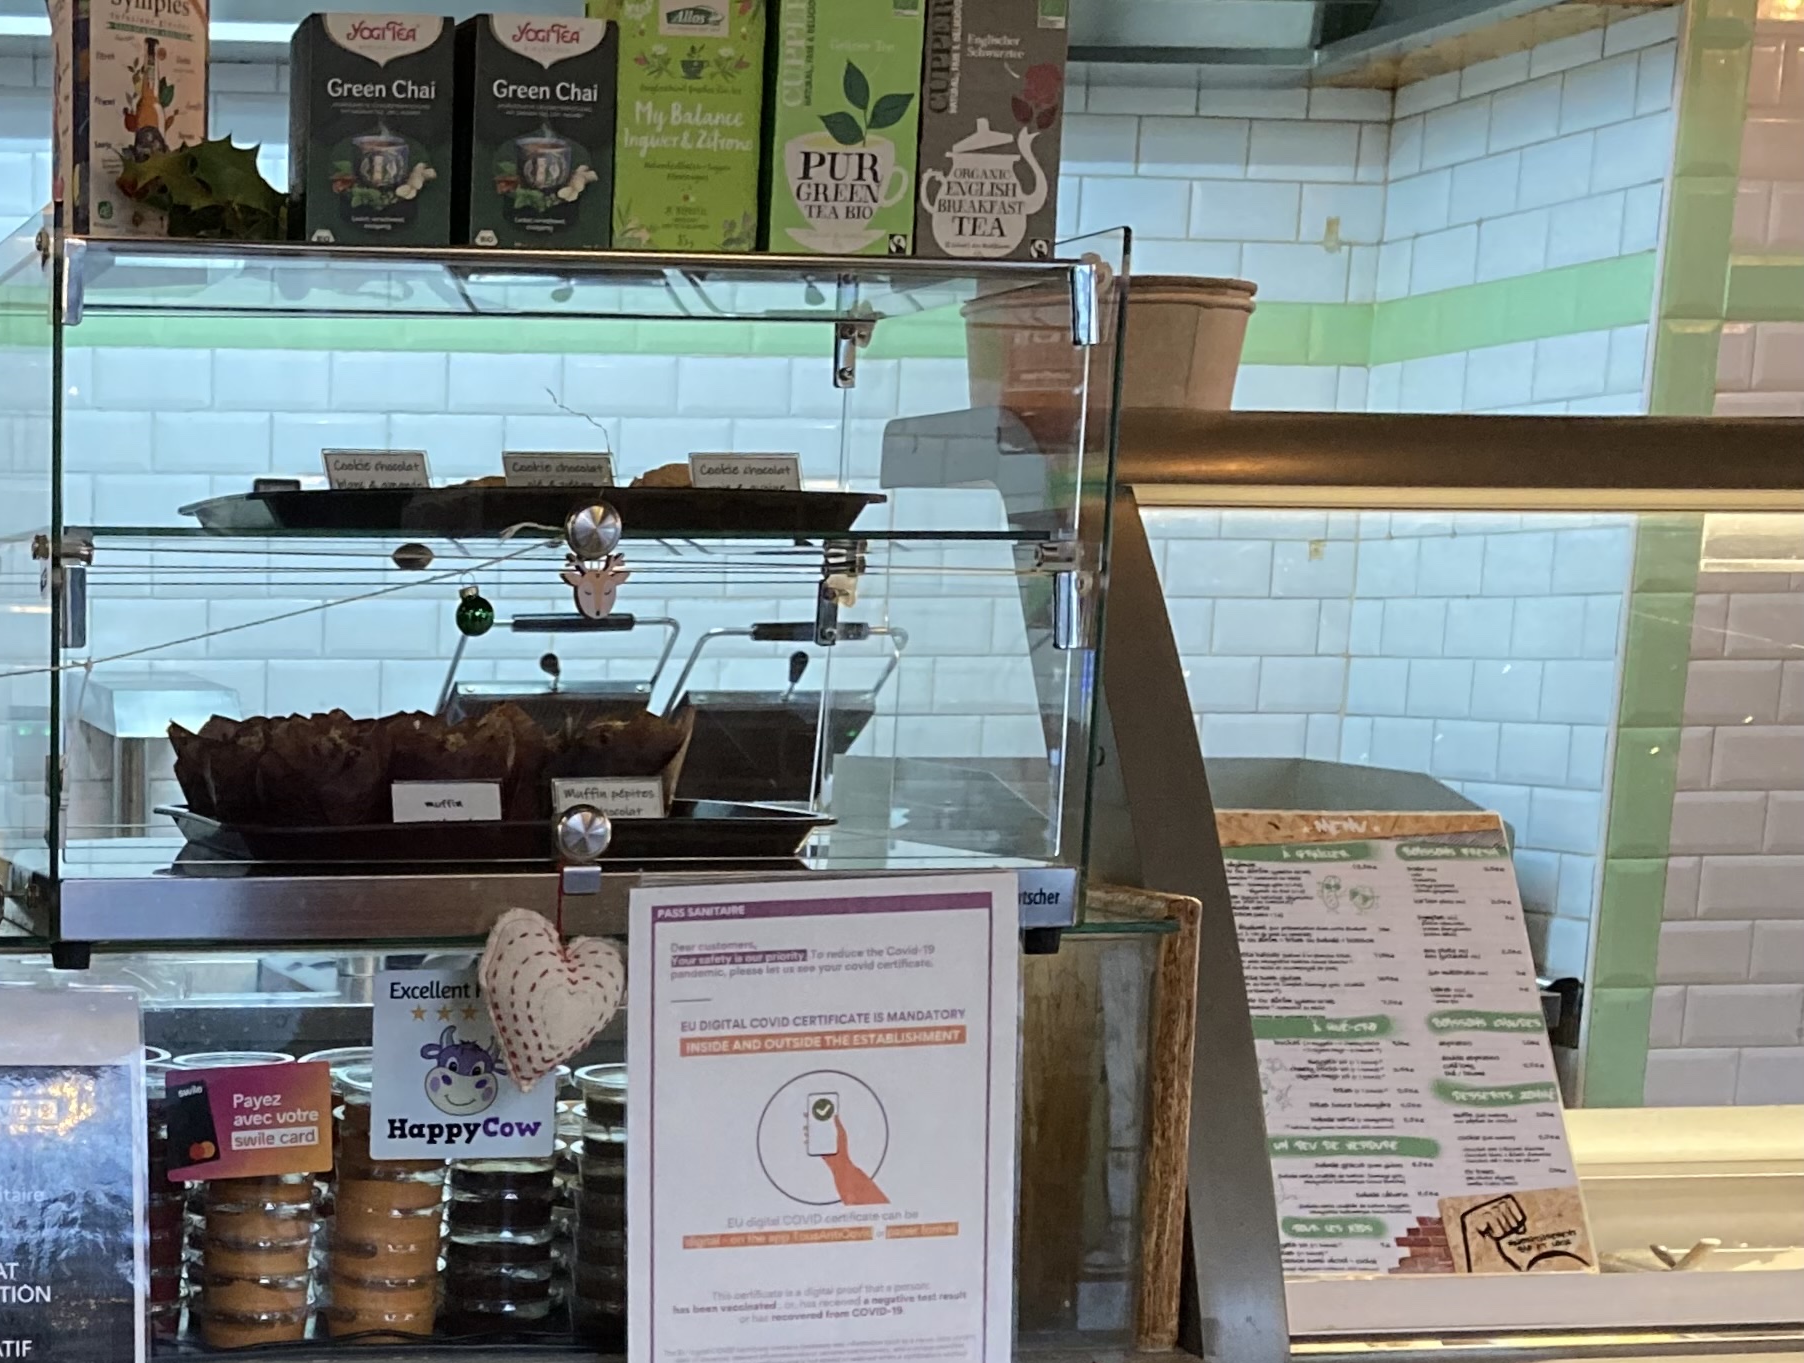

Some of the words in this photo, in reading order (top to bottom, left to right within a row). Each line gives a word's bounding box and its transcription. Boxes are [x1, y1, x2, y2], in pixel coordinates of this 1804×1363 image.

[671, 9, 707, 25] Allos
[967, 34, 1021, 47] Englischer
[327, 77, 386, 99] Green
[392, 79, 436, 99] Chai
[493, 79, 550, 100] Green
[556, 82, 598, 102] Chai
[634, 101, 664, 131] My
[671, 102, 744, 126] Balance
[624, 128, 677, 158] Ingwer
[681, 133, 693, 149] &
[697, 129, 754, 152] Zitrone
[798, 151, 883, 183] PUR
[953, 168, 1013, 180] ORGANIC
[796, 182, 881, 204] GREEN
[946, 181, 1017, 198] ENGLISH
[804, 204, 839, 220] TEA
[845, 204, 874, 220] BIO
[937, 200, 1024, 215] BREAKFAST
[952, 216, 1007, 237] TEA
[334, 459, 370, 472] Cookie
[374, 460, 420, 472] chocolat
[512, 461, 552, 473] Cookie
[556, 462, 604, 473] chocolat
[700, 464, 739, 475] Cookie
[743, 464, 791, 475] chocolat
[563, 787, 607, 800] Muffin
[611, 788, 655, 801] pépites
[424, 799, 464, 809] muffin
[601, 804, 644, 816] hocolat
[1314, 818, 1367, 836] MENU
[1018, 886, 1060, 906] rtscher
[657, 908, 685, 919] PASS
[687, 905, 745, 918] SANITAIRE
[671, 943, 695, 952] Dear
[671, 956, 697, 966] Your
[699, 954, 733, 966] safety
[734, 954, 742, 963] is
[745, 954, 763, 963] our
[810, 950, 824, 960] To
[827, 948, 863, 958] reduce
[867, 948, 884, 957] the
[886, 945, 935, 957] Covid-19
[671, 968, 726, 980] pandemic,
[729, 967, 763, 978] please
[766, 964, 780, 974] let
[783, 965, 794, 974] us
[797, 964, 816, 973] see
[818, 963, 842, 974] your
[845, 961, 874, 971] covid
[390, 980, 471, 1000] Excellent
[681, 1022, 697, 1032] EU
[699, 1018, 747, 1031] DIGITAL
[750, 1017, 790, 1029] COVID
[793, 1012, 871, 1027] CERTIFICATE
[874, 1011, 884, 1023] IS
[888, 1008, 966, 1022] MANDATORY
[686, 1040, 729, 1054] INSIDE
[732, 1038, 761, 1051] AND
[764, 1035, 822, 1050] OUTSIDE
[824, 1034, 848, 1047] THE
[852, 1029, 960, 1045] ESTABLISHMENT
[178, 1083, 203, 1097] swile
[232, 1093, 282, 1110] Payez
[233, 1112, 271, 1127] avec
[276, 1109, 319, 1125] votre
[234, 1130, 276, 1147] swile
[280, 1129, 316, 1145] card
[387, 1117, 542, 1146] HappyCow
[727, 1218, 744, 1228] EU
[746, 1216, 780, 1229] digital
[782, 1214, 823, 1226] COVID
[825, 1211, 879, 1224] certificate
[882, 1212, 902, 1221] can
[904, 1210, 919, 1220] be
[731, 1236, 745, 1244] on
[747, 1233, 765, 1243] the
[769, 1234, 790, 1245] app
[713, 1291, 732, 1300] This
[734, 1288, 784, 1300] certificate
[804, 1287, 834, 1299] digital
[836, 1285, 863, 1297] proof
[865, 1284, 883, 1293] that
[672, 1305, 690, 1314] has
[693, 1303, 718, 1313] been
[721, 1301, 776, 1312] vaccinated
[799, 1299, 817, 1308] has
[819, 1297, 861, 1308] received
[872, 1294, 916, 1307] negative
[918, 1292, 937, 1302] test
[939, 1290, 966, 1301] result
[752, 1314, 768, 1323] has
[771, 1311, 822, 1322] recovered
[826, 1309, 849, 1319] from
[852, 1306, 903, 1319] COVID-19
